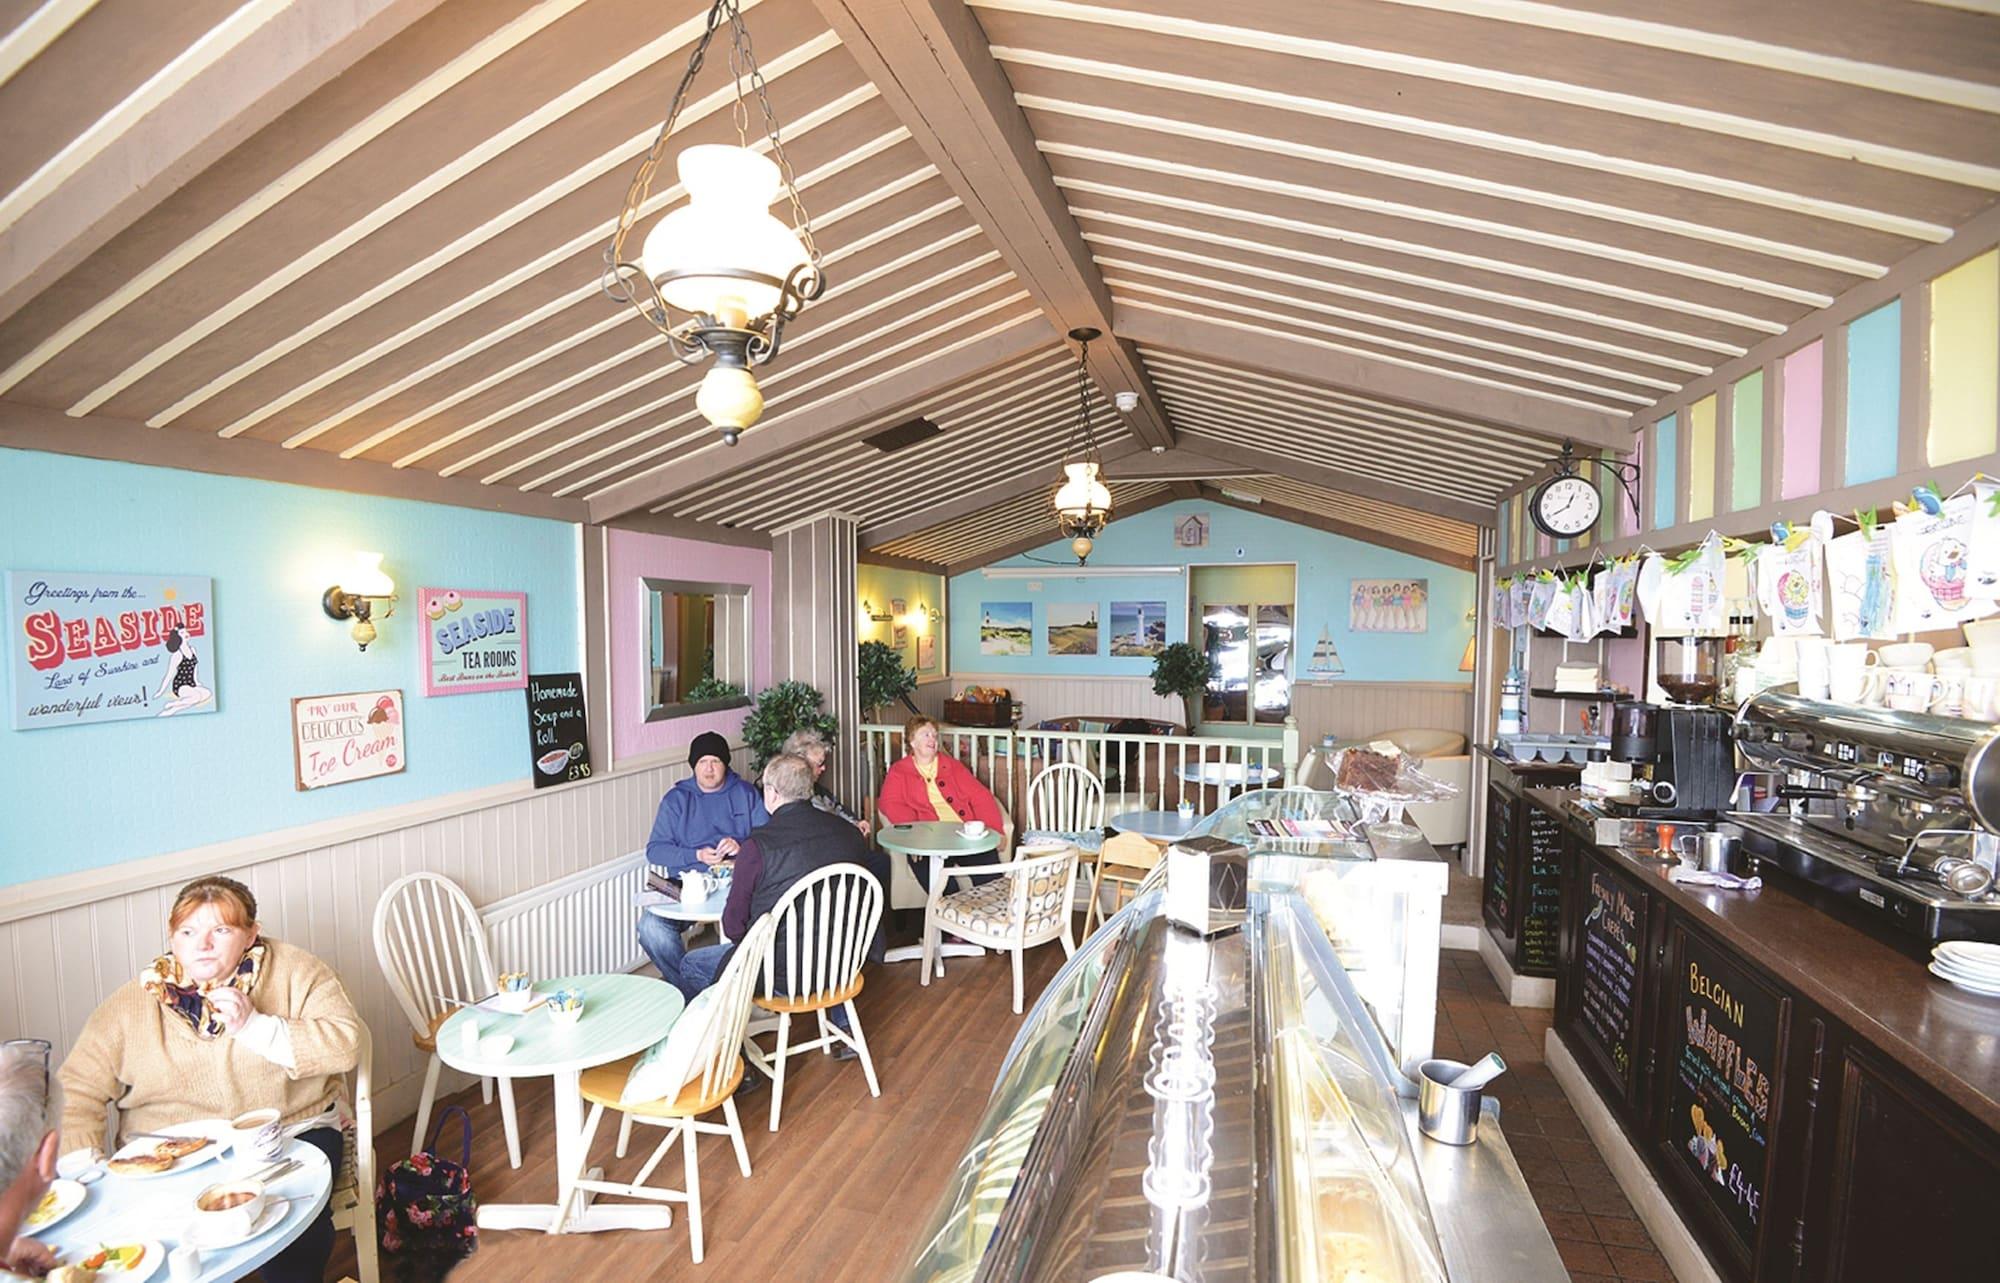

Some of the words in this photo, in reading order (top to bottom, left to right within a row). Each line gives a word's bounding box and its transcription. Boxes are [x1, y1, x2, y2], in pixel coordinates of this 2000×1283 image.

[24, 581, 90, 605] Greetings
[90, 588, 119, 603] from
[24, 602, 205, 671] SEASIDE
[436, 608, 516, 655] SEASIDE
[44, 673, 73, 690] Land
[78, 668, 90, 685] of
[94, 660, 139, 678] Sunshine
[142, 654, 160, 666] and
[462, 651, 481, 669] TEA
[484, 650, 517, 668] ROOMS
[29, 693, 101, 716] wonderful
[108, 686, 148, 708] views!
[531, 681, 579, 703] Homemade
[307, 705, 328, 717] TRY
[333, 702, 359, 713] OUR
[534, 709, 558, 727] Soup
[560, 706, 575, 718] and
[576, 709, 582, 718] a
[302, 719, 365, 741] DELICIOUS
[536, 728, 559, 747] Roll.
[309, 751, 336, 781] Ice
[343, 736, 397, 767] Cream
[1689, 962, 1744, 1029] BELGIAN
[1685, 1005, 1769, 1122] WAFFLES
